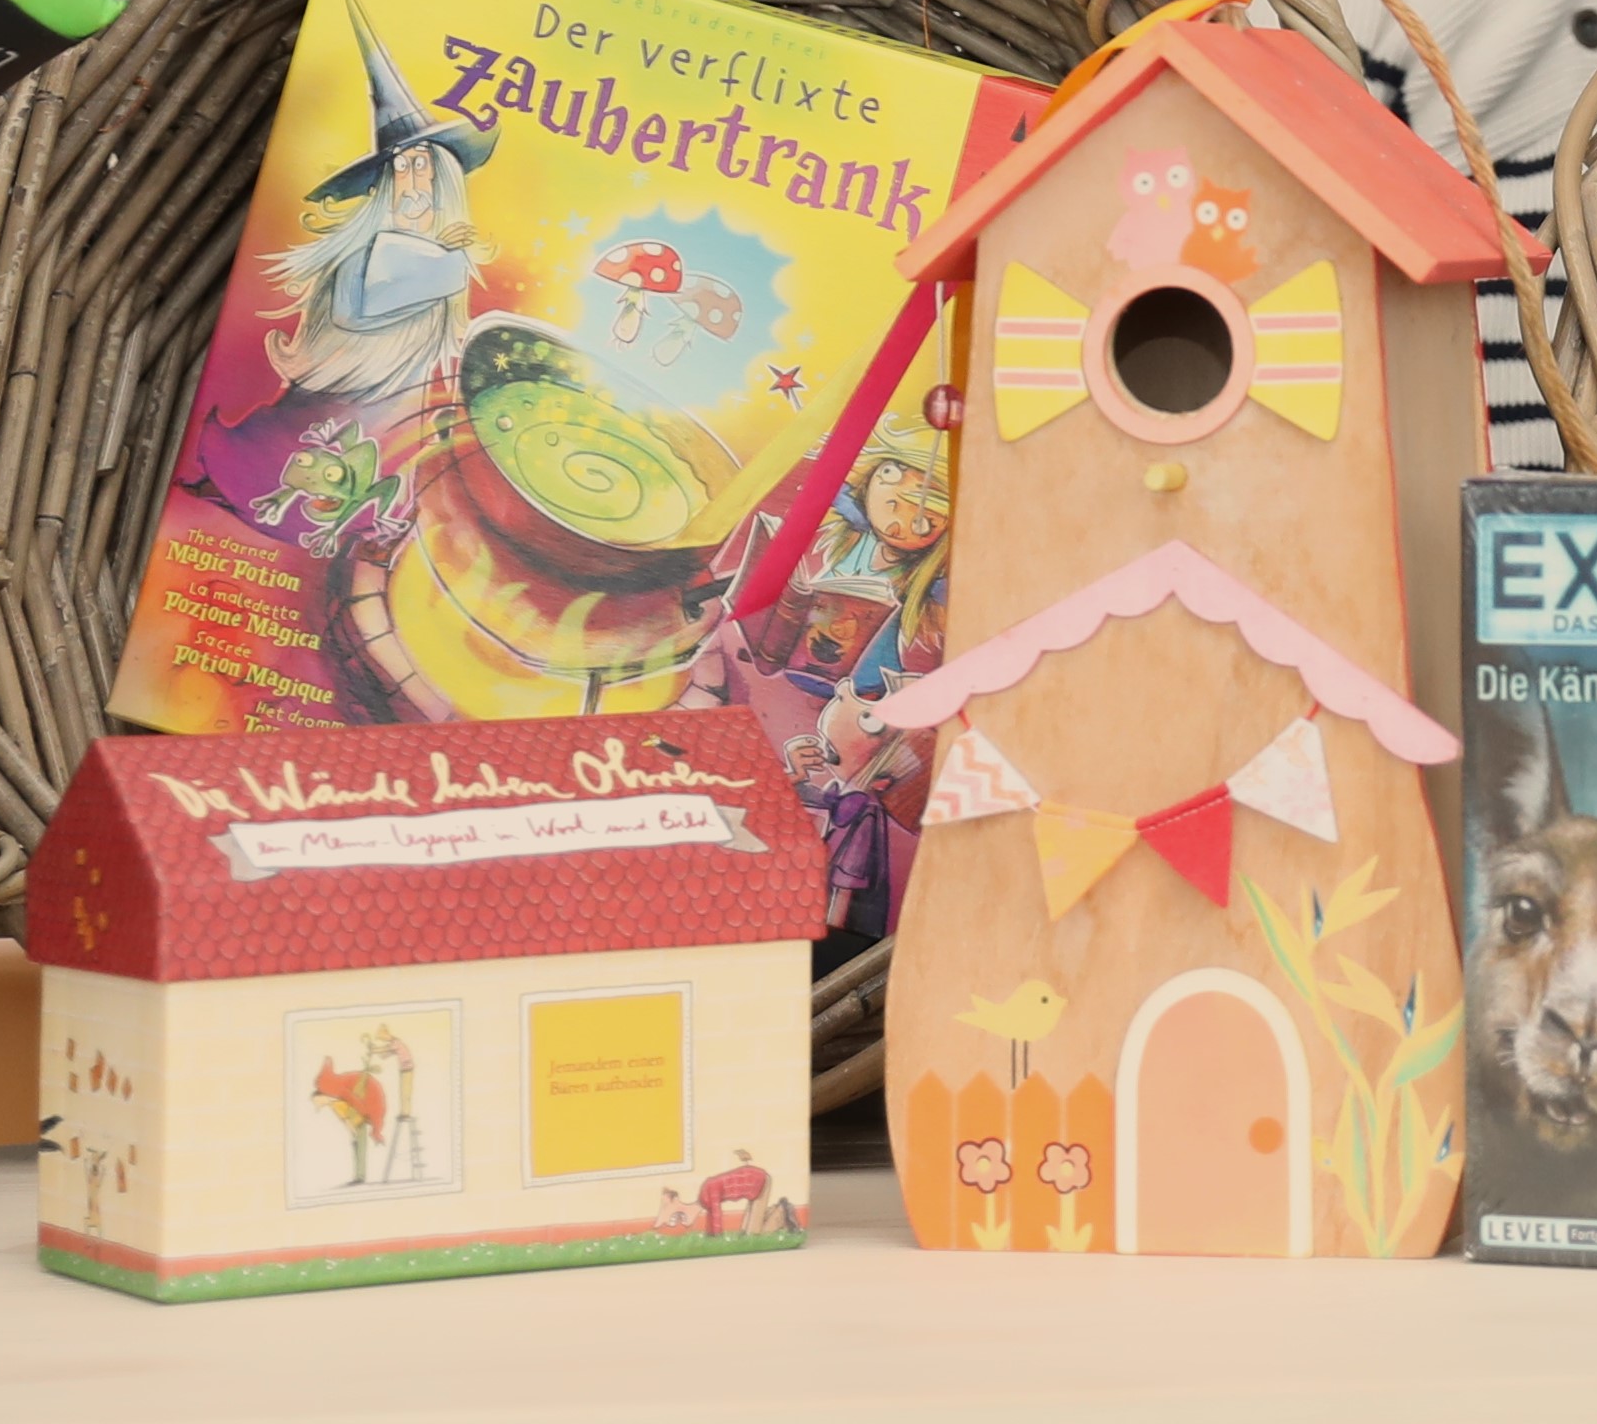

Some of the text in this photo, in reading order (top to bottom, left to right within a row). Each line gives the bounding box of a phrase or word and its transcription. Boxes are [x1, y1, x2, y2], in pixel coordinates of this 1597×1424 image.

[533, 3, 883, 125] Der verflixte
[431, 34, 932, 244] Zaubertrank
[165, 540, 229, 571] Magic
[188, 528, 279, 563] The darned
[189, 582, 300, 622] La maledetta
[195, 630, 253, 660] Sacrée
[244, 612, 322, 651] Magica
[244, 662, 335, 706] Magique
[1477, 665, 1529, 703] Die
[255, 701, 285, 722] Het
[149, 737, 756, 819] Die Wände haben Ohren
[604, 818, 649, 834] und
[658, 806, 715, 831] Bild
[547, 1056, 665, 1078] Jemandem einen
[595, 1074, 663, 1093] aufbinden
[1488, 1221, 1563, 1244] LEVEL
